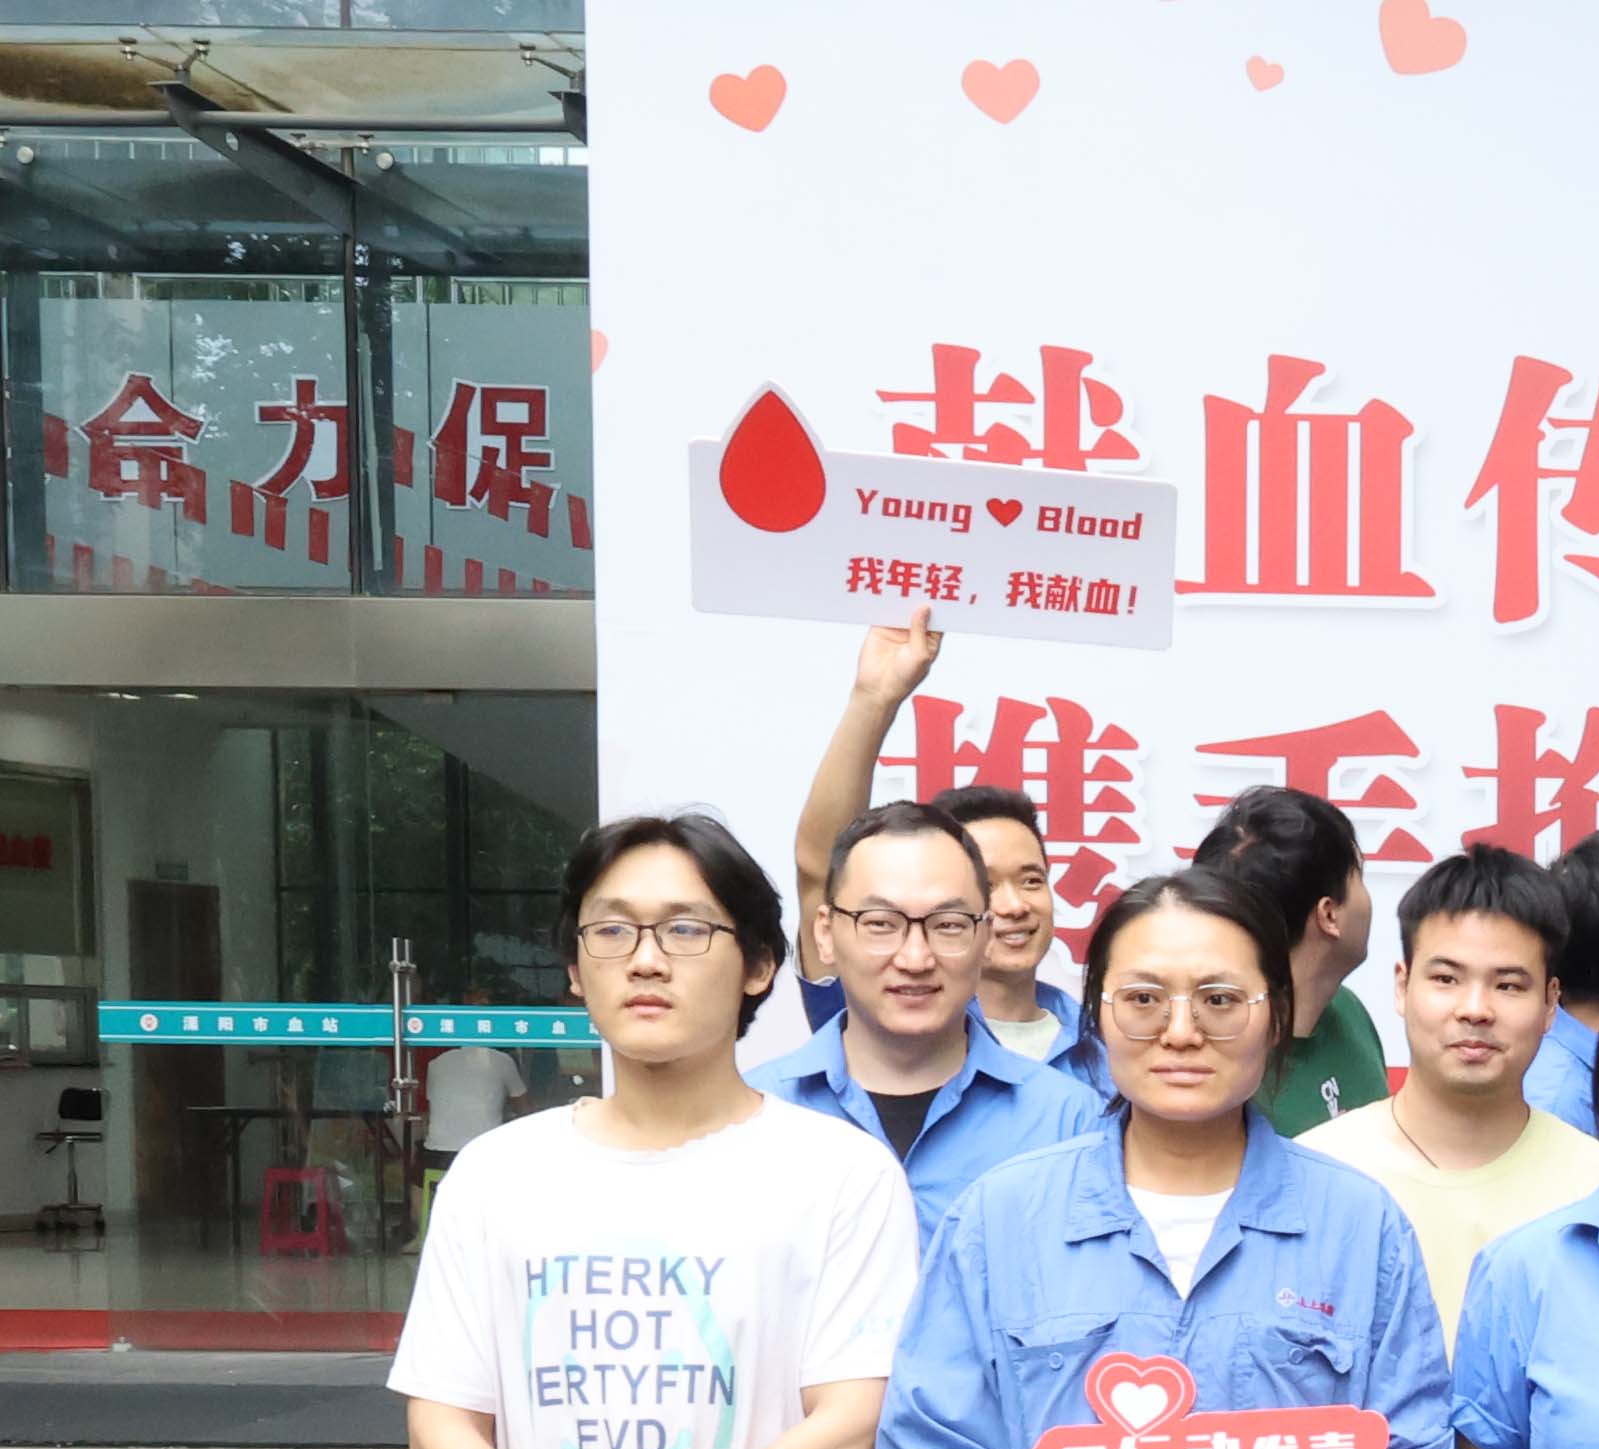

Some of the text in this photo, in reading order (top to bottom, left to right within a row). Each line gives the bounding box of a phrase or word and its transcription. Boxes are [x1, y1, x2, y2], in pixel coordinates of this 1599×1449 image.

[856, 488, 1143, 541] Young Blood
[526, 1255, 725, 1299] HTERKY
[570, 1309, 672, 1350] HOT
[528, 1363, 735, 1406] ERTYFTN
